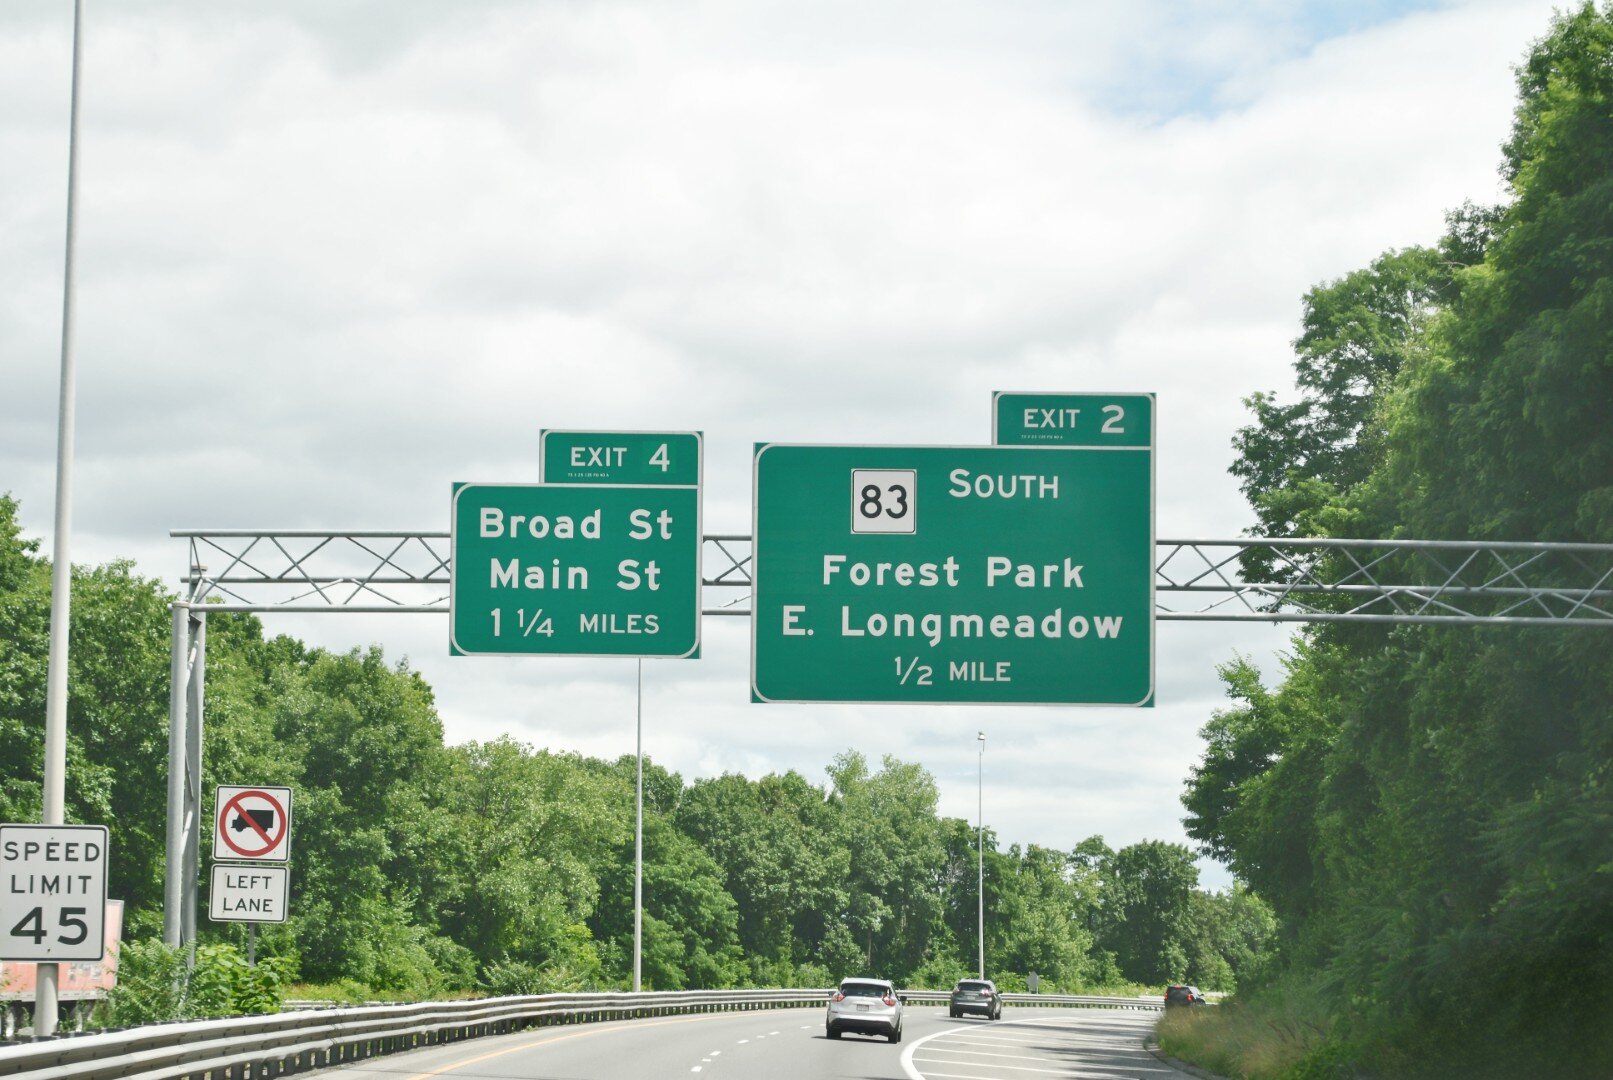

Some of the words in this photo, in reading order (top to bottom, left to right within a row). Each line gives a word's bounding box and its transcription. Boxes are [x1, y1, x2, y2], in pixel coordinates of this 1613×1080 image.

[1024, 409, 1080, 428] EXIT
[1101, 405, 1124, 433] 2
[571, 447, 627, 466] EXIT
[649, 444, 670, 472] 4
[949, 469, 1058, 498] SOUTH
[860, 485, 908, 519] 83
[480, 508, 601, 539] Broad
[629, 509, 672, 540] St
[491, 558, 588, 589] Main
[617, 559, 660, 590] St
[823, 555, 960, 586] Forest
[987, 557, 1084, 587] Park
[490, 608, 501, 637] 1
[580, 614, 660, 634] MILES
[783, 606, 814, 635] E.
[841, 606, 1122, 647] Longmeadow
[950, 662, 1011, 682] MILE
[4, 842, 99, 861] SPEED
[11, 875, 91, 894] LIMIT
[227, 875, 272, 889] LEFT
[223, 898, 273, 912] LANE
[10, 907, 87, 945] 45
